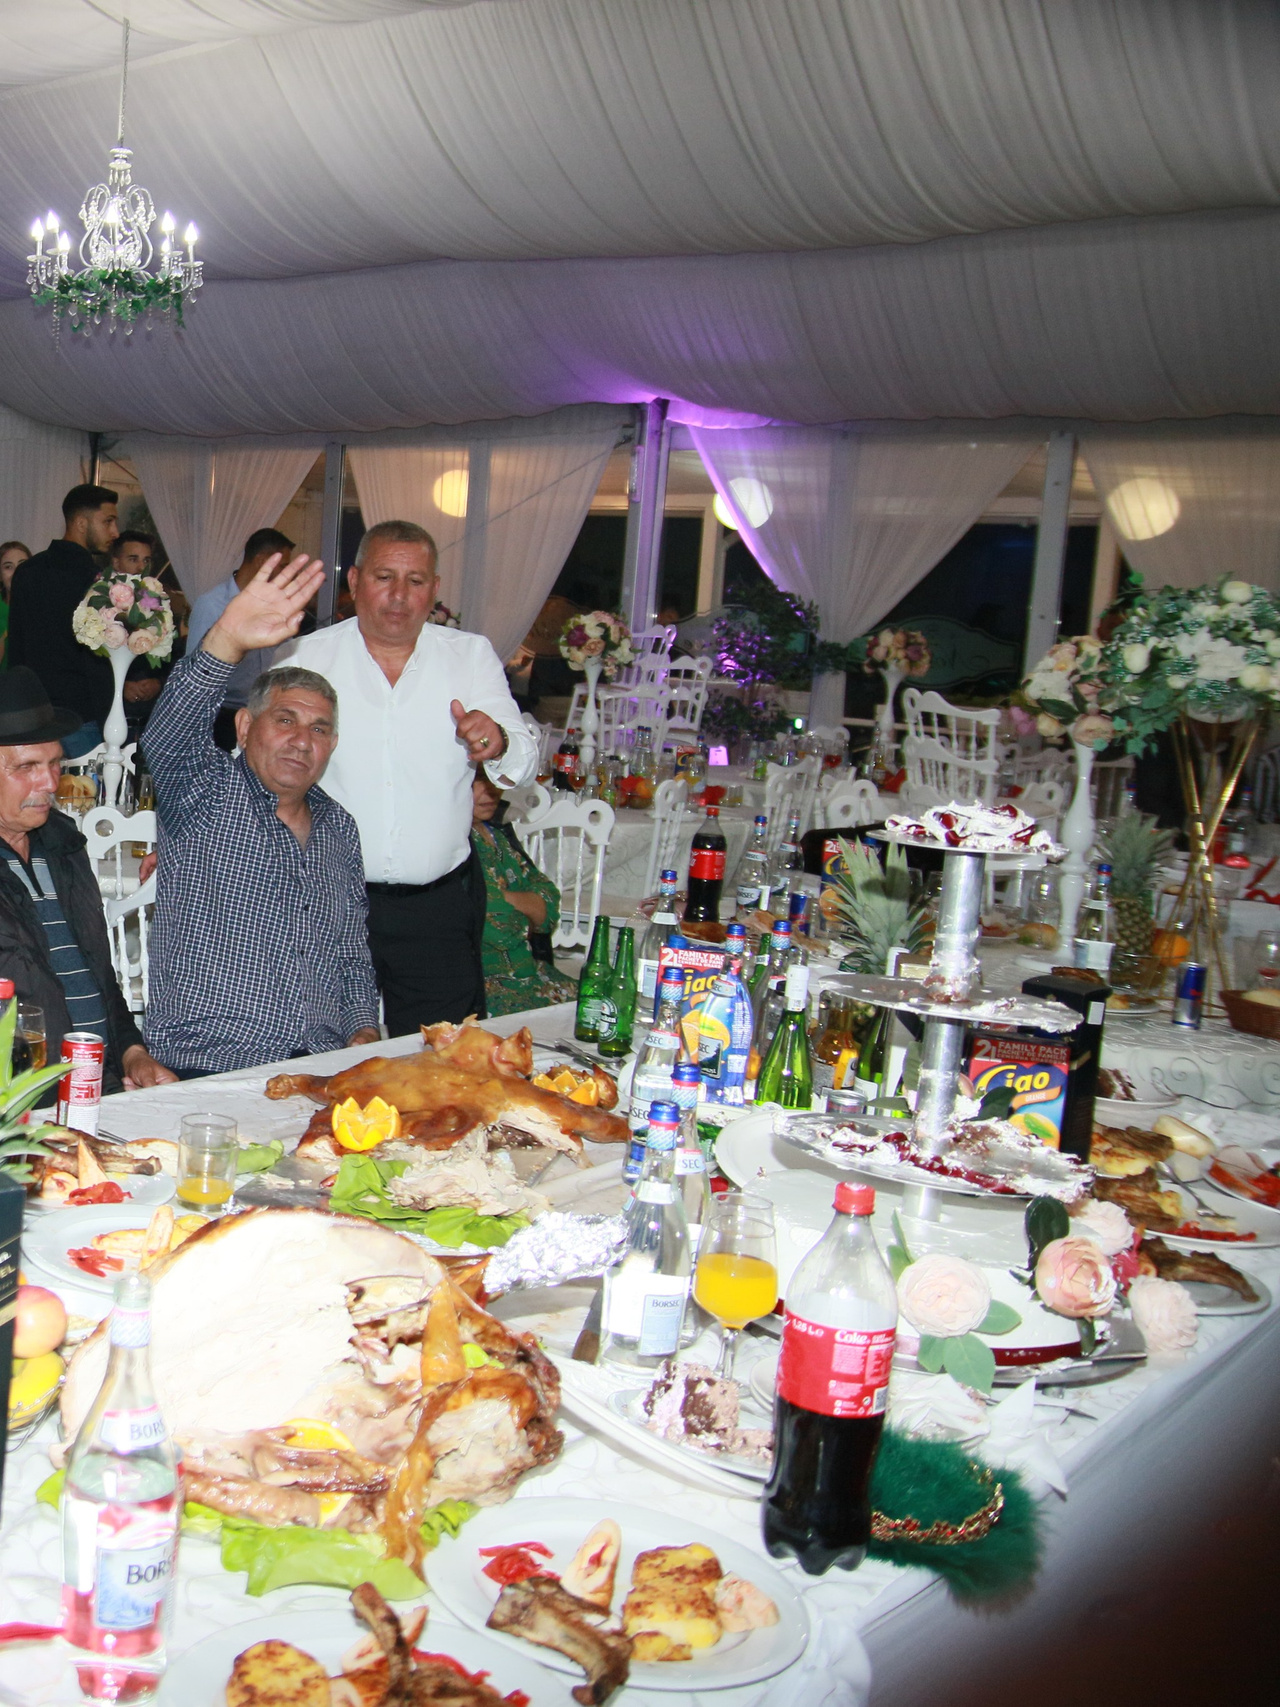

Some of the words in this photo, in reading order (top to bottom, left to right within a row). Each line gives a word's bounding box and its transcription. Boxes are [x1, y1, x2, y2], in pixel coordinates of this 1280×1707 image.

[661, 947, 682, 967] 2L
[678, 949, 708, 959] FAMILY
[710, 953, 725, 961] PAC
[975, 1039, 1002, 1062] 2L
[998, 1041, 1036, 1053] FAMILY
[1039, 1045, 1067, 1056] PACK
[130, 1418, 166, 1441] BORS
[126, 1556, 173, 1586] BORS
